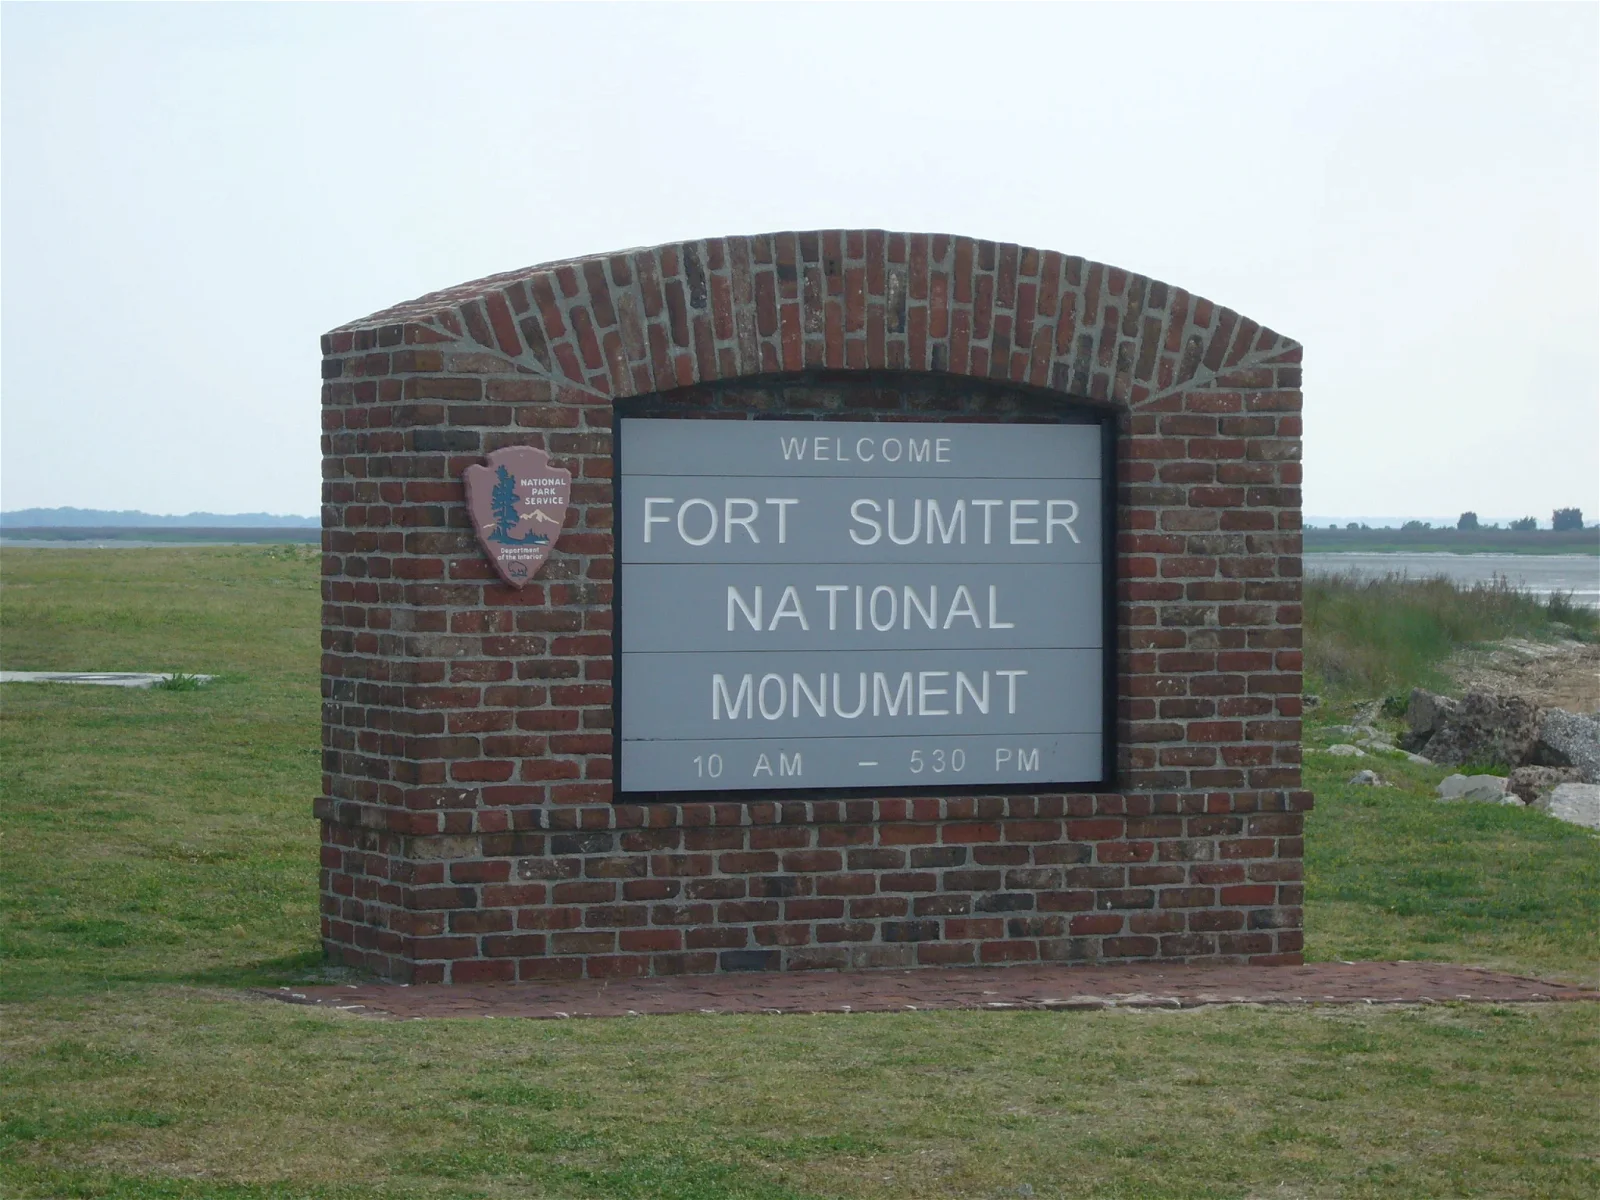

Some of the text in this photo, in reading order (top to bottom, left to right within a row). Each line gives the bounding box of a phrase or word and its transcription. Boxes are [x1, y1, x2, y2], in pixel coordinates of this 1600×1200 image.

[780, 436, 951, 464] WELCOME
[524, 497, 564, 505] SERVICE
[643, 496, 1081, 548] FORT SUMTER
[726, 584, 1015, 633] NATIONAL
[711, 669, 1029, 721] MONUMENT
[693, 754, 724, 779] 10
[752, 752, 803, 778] AM
[909, 748, 967, 774] 530
[995, 747, 1040, 773] PM
